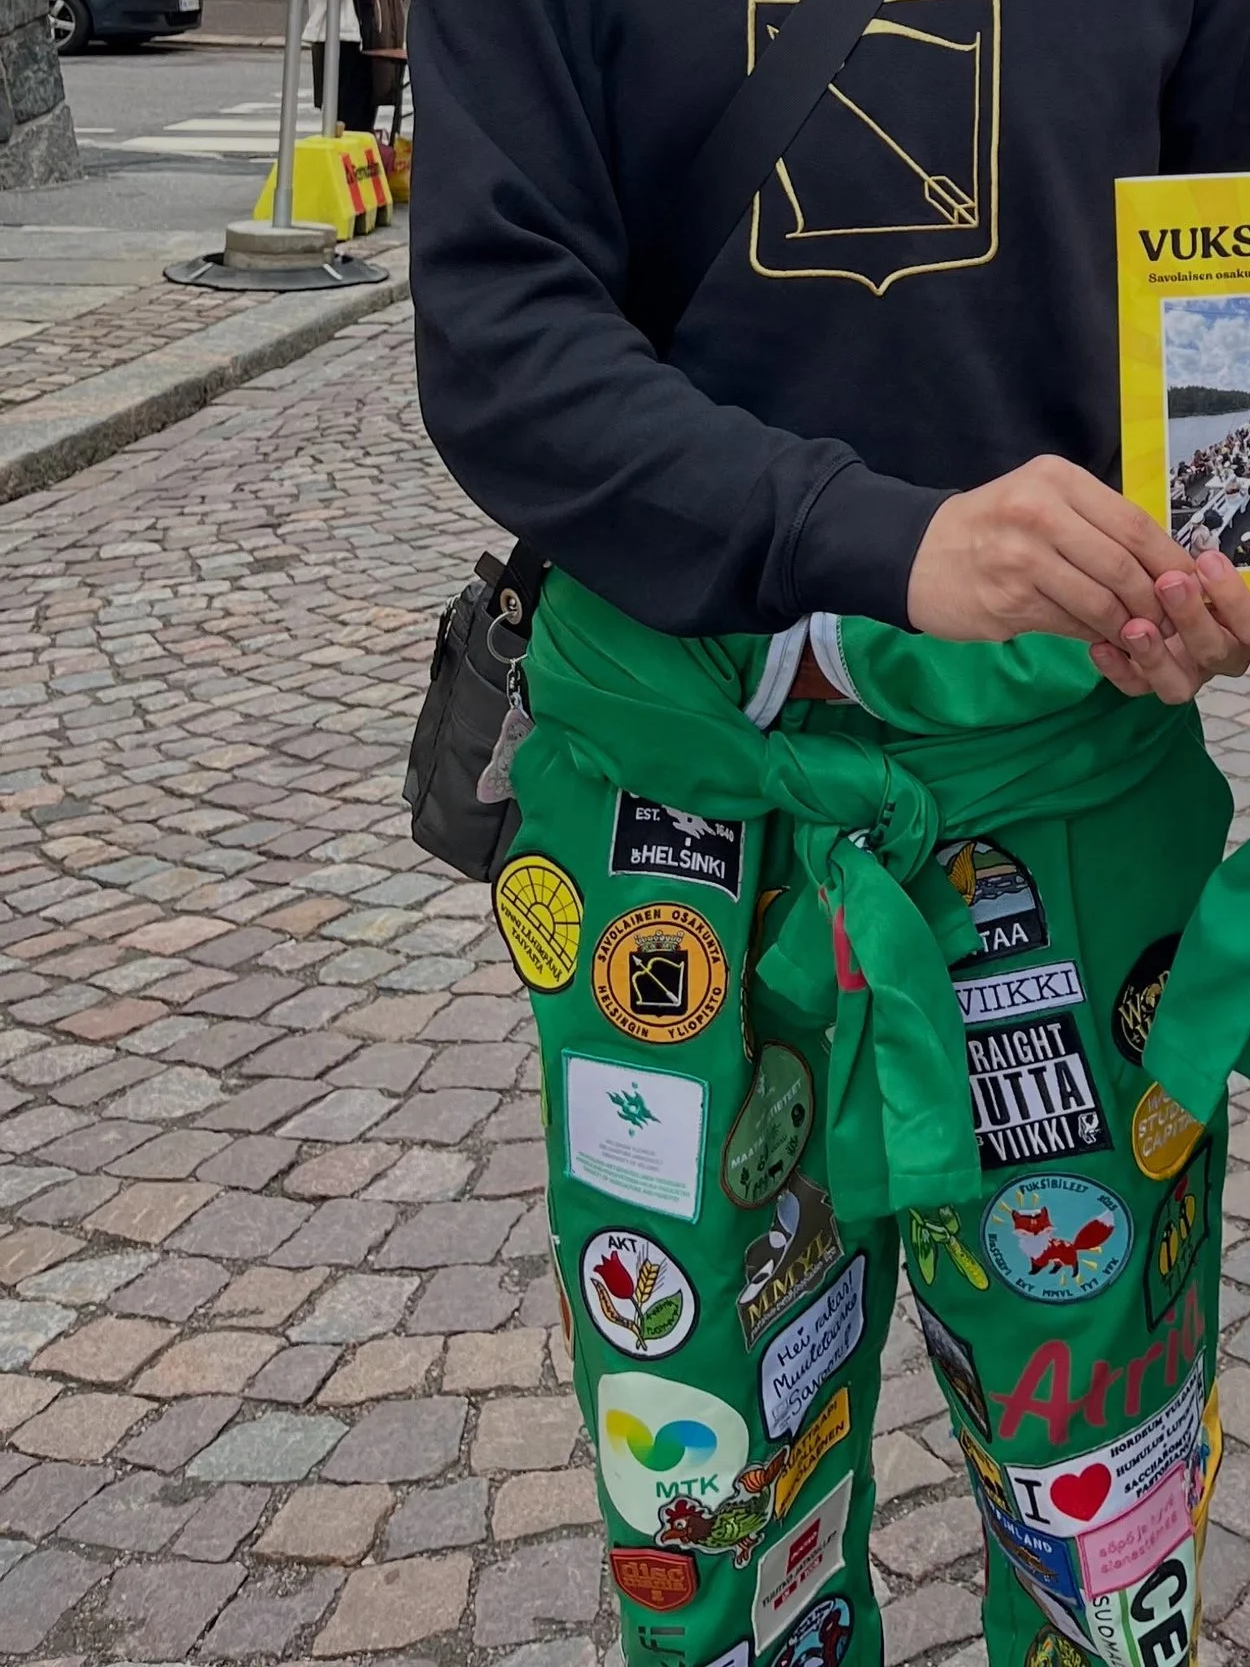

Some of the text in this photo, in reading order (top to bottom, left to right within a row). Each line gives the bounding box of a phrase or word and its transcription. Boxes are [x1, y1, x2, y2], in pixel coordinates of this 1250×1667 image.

[1148, 271, 1213, 284] Savolaisen
[635, 807, 735, 843] EST. 1640
[641, 844, 726, 879] HELSINKI
[597, 908, 721, 964] SAVOLAINEN OSAKUNTA
[972, 922, 1029, 955] TAA
[597, 985, 723, 1039] HELSINGIN YLIOPISTO
[955, 969, 1079, 1016] VIIKKI
[967, 1022, 1066, 1073] RAIGHT
[987, 1116, 1075, 1162] VIIKKI
[1019, 1178, 1089, 1195] FUKSIBILEET
[608, 1235, 638, 1254] AKT
[777, 1326, 811, 1367] Hei
[1110, 1417, 1164, 1458] HORDEUM
[1115, 1431, 1165, 1478] HUMULUS
[656, 1474, 720, 1499] MTK
[1014, 1477, 1051, 1525] I
[620, 1561, 686, 1583] disc
[1131, 1558, 1190, 1667] CE
